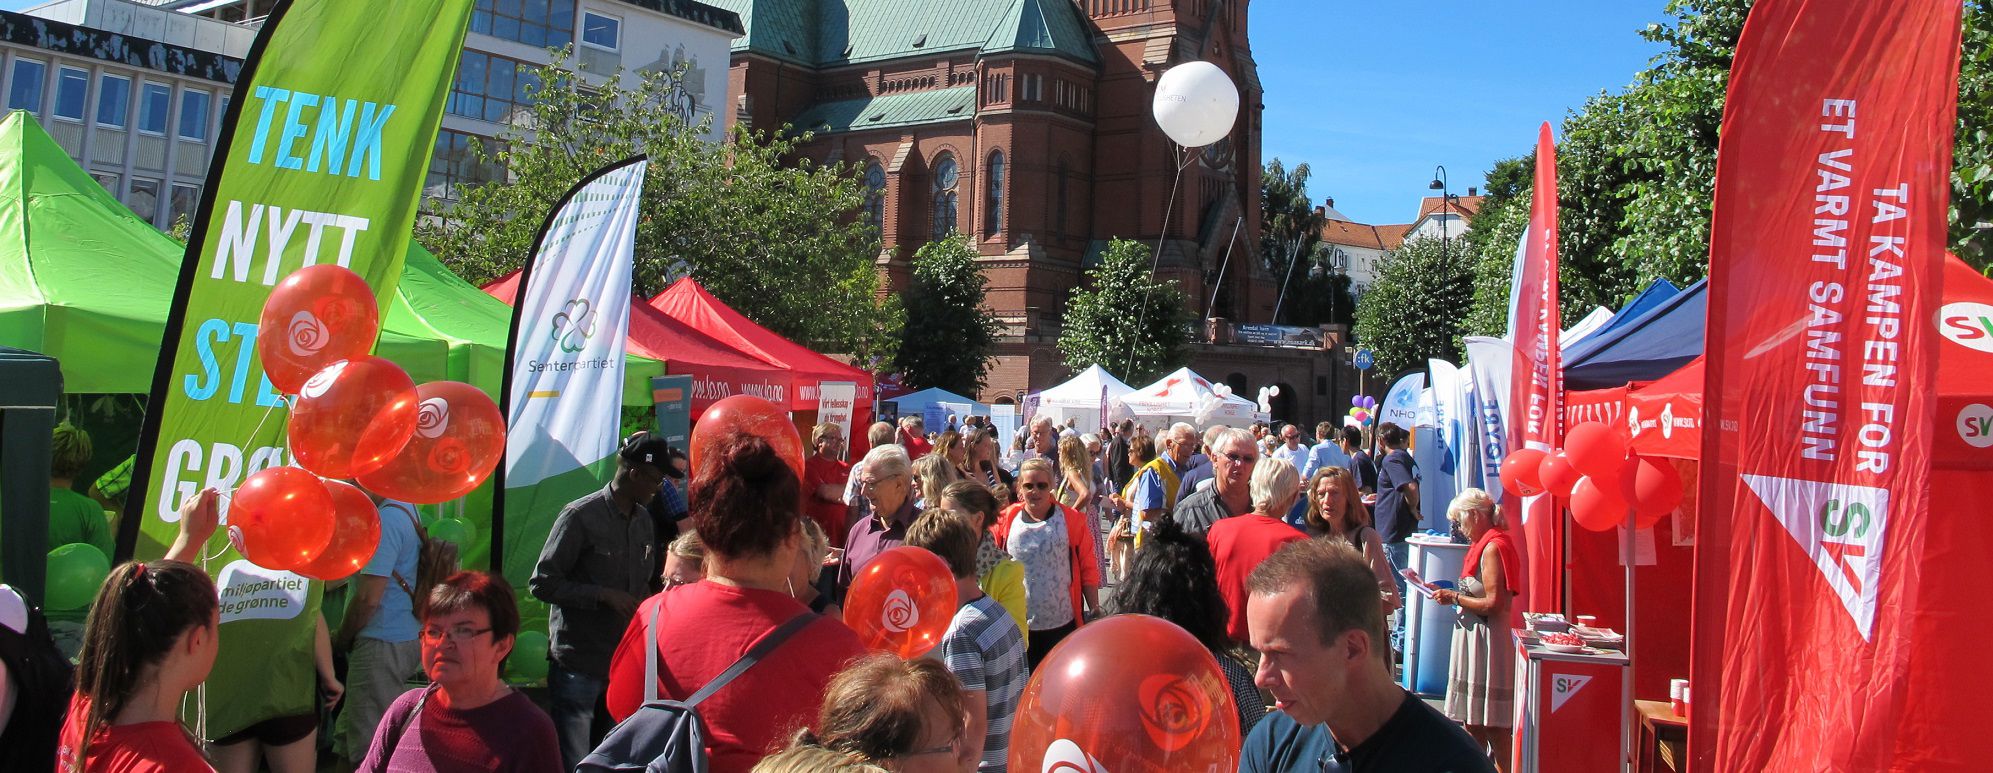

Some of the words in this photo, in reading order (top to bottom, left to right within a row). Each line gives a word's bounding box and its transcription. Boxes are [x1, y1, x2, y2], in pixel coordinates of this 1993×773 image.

[248, 86, 396, 181] TENK
[1820, 98, 1857, 139] ET
[1811, 149, 1853, 270] VARMT
[1871, 183, 1908, 224] TA
[211, 201, 369, 286] NYTT
[1862, 236, 1905, 387] KAMPEN
[528, 357, 615, 373] Senterpartiet
[1801, 280, 1844, 461] SAMFUNN
[1389, 408, 1416, 419] NHO
[1964, 416, 1993, 437] SV
[1856, 402, 1894, 474] FOR
[1819, 498, 1872, 596] SV
[221, 577, 302, 598] miljøpartiet
[235, 597, 289, 614] grønne
[1555, 677, 1582, 693] SV
